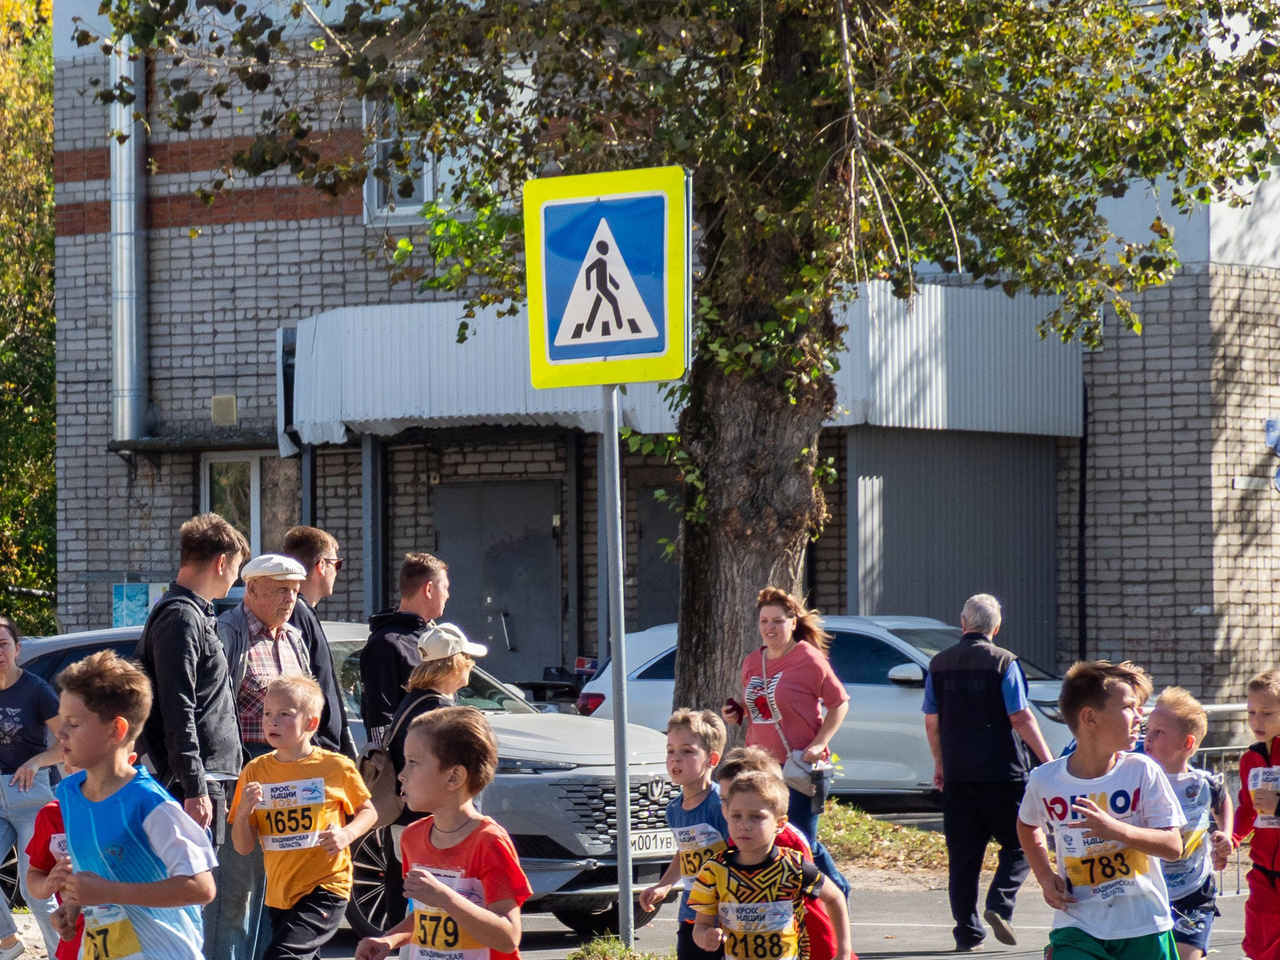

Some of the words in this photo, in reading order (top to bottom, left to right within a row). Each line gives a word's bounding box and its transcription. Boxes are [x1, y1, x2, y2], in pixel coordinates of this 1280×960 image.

[270, 785, 290, 794] КРОСС
[270, 791, 297, 800] НАЦИИ
[272, 798, 298, 808] 2024
[265, 807, 313, 834] 1655
[1081, 853, 1131, 885] 783
[736, 914, 766, 923] НАЦИИ
[418, 914, 459, 948] 579
[729, 931, 783, 959] 2188
